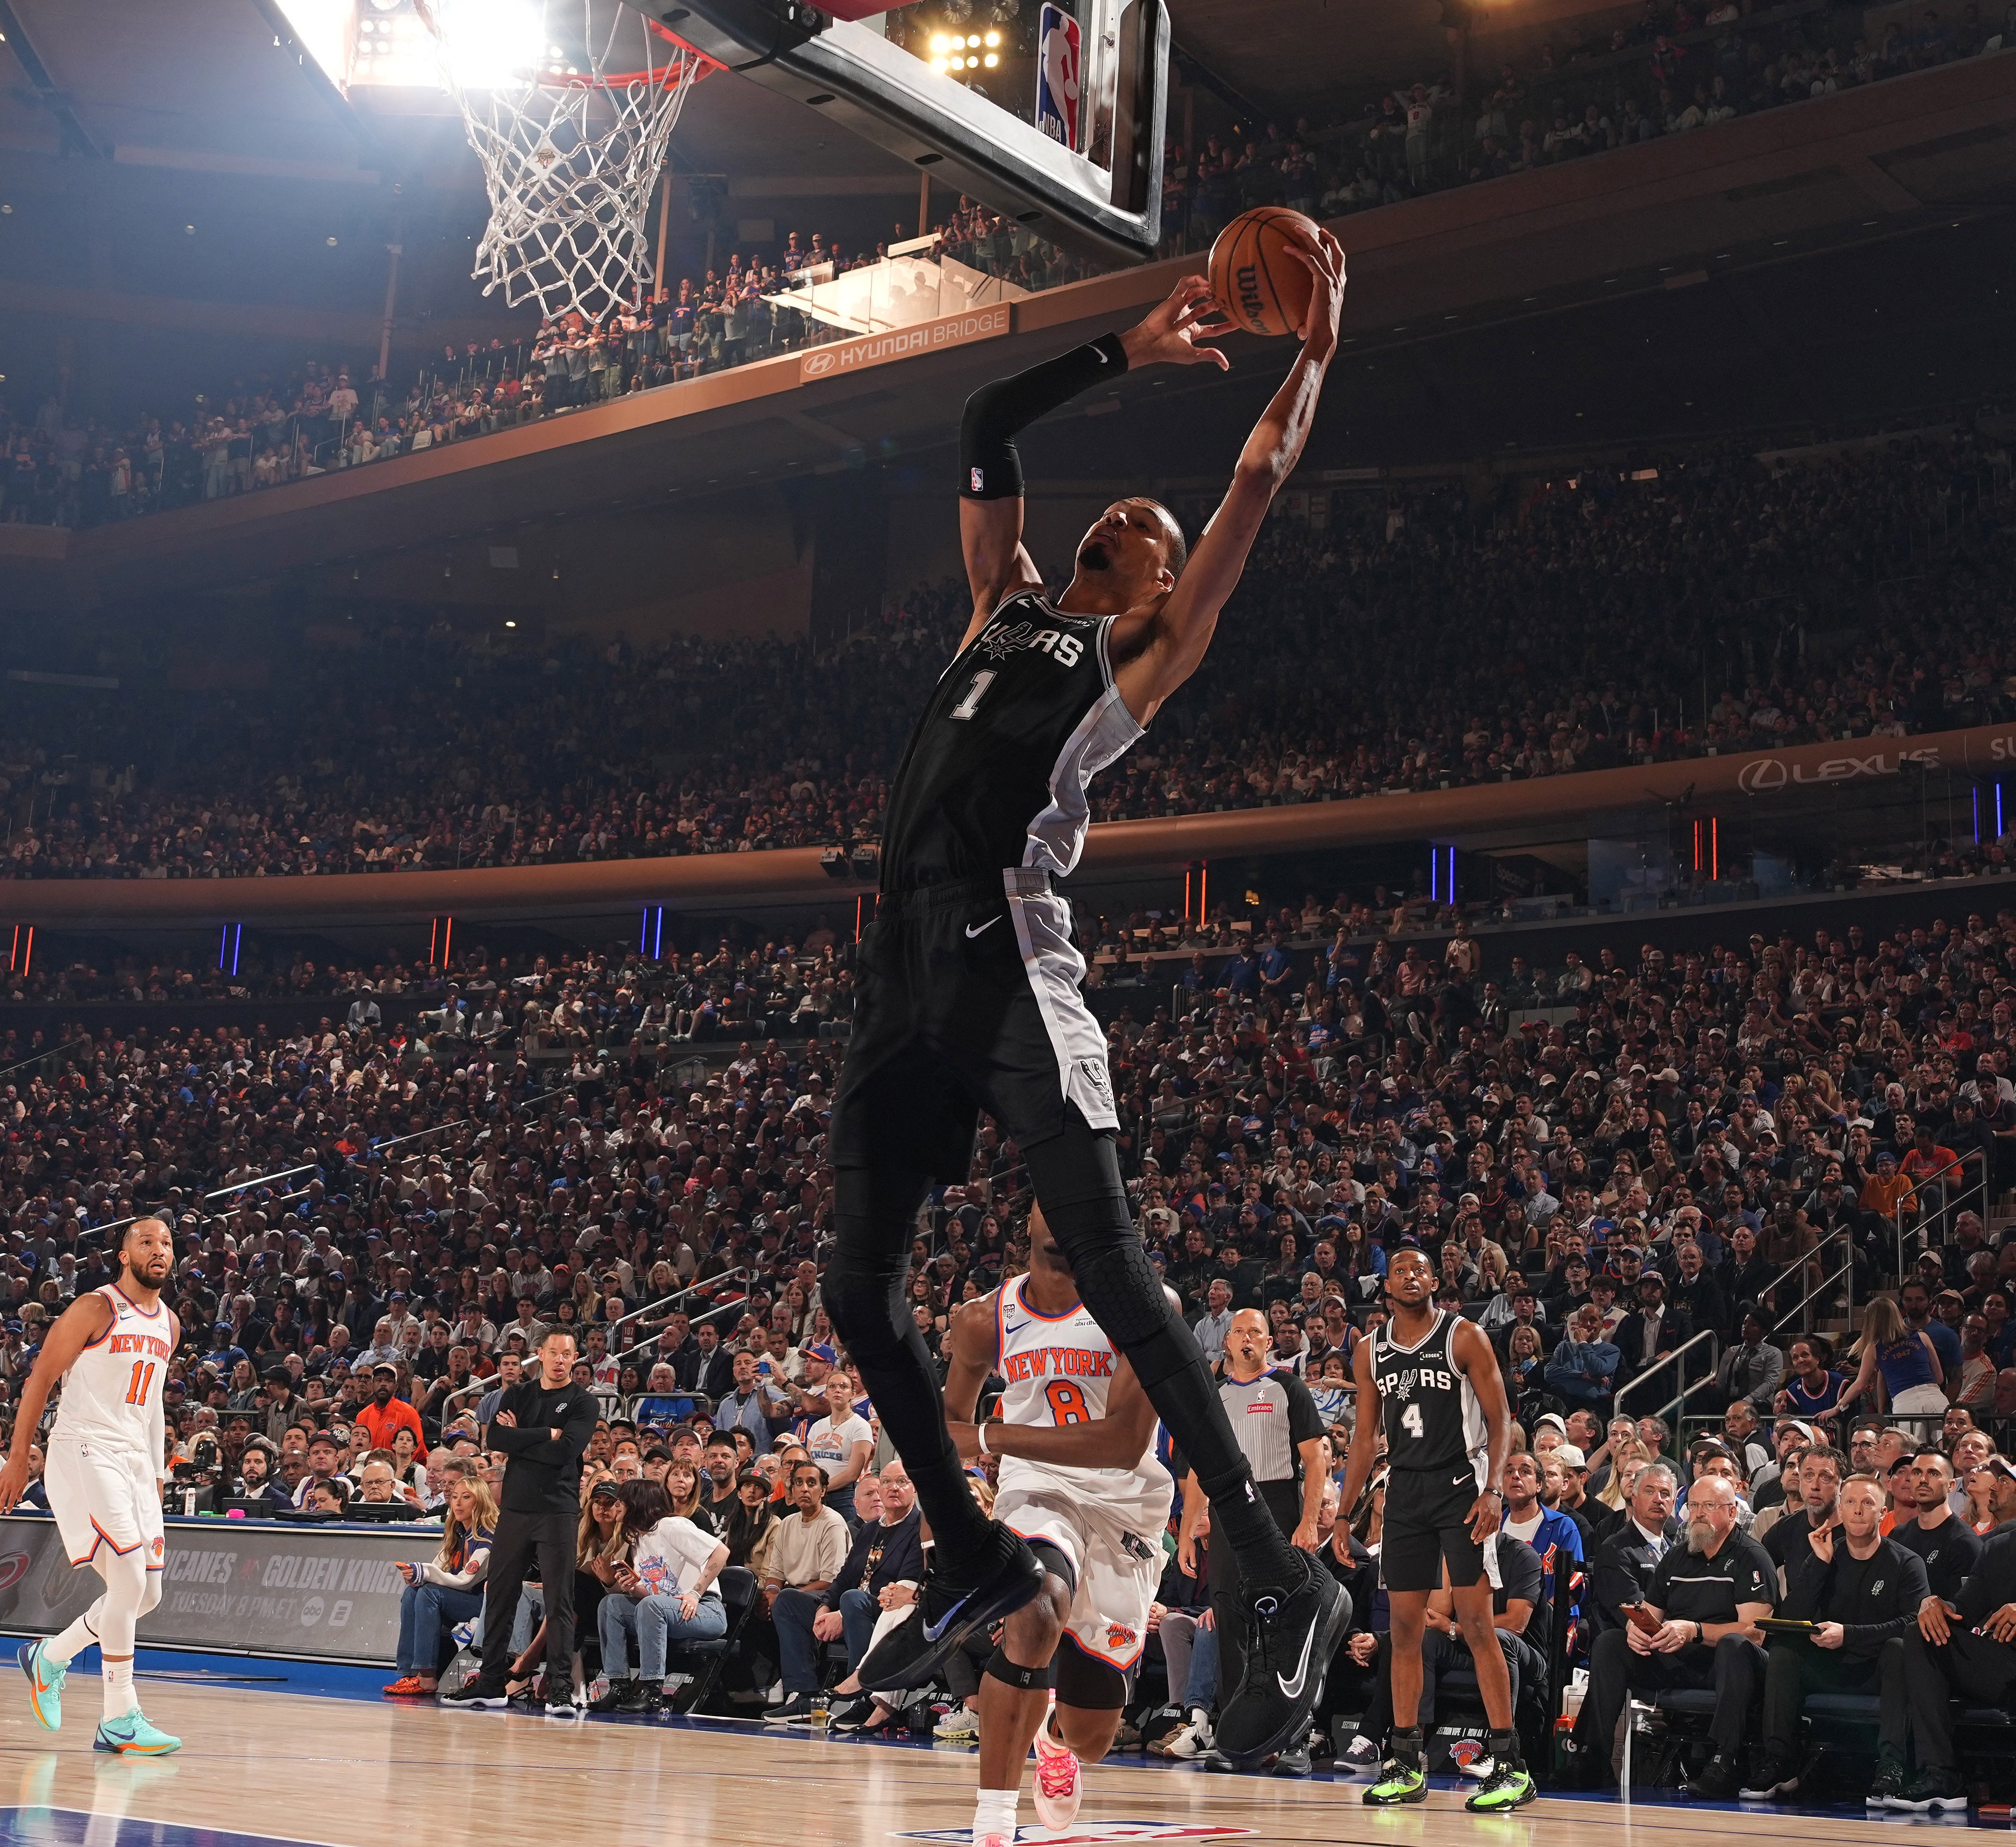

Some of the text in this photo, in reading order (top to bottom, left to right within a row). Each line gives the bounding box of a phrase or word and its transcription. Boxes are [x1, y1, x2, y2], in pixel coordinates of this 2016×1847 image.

[1043, 111, 1061, 142] NBA
[1236, 263, 1272, 331] Wilson
[841, 310, 1006, 366] HYUNDAI BRIDGE
[949, 669, 998, 720] 1
[1793, 748, 1940, 784] LEXUS
[624, 1327, 634, 1335] 107
[109, 1334, 170, 1365] NEW YORK
[1004, 1347, 1112, 1384] NEW YORK
[1881, 1341, 1920, 1361] CHAMPION
[125, 1360, 155, 1406] 11
[1044, 1379, 1091, 1428] 8
[1401, 1403, 1424, 1437] 4
[811, 1450, 842, 1461] KNICKS
[816, 1433, 844, 1447] NEW YORK
[262, 1555, 345, 1591] GOLDEN
[170, 1591, 238, 1616] TUESDAY
[237, 1596, 247, 1616] 8
[304, 1605, 322, 1616] abc
